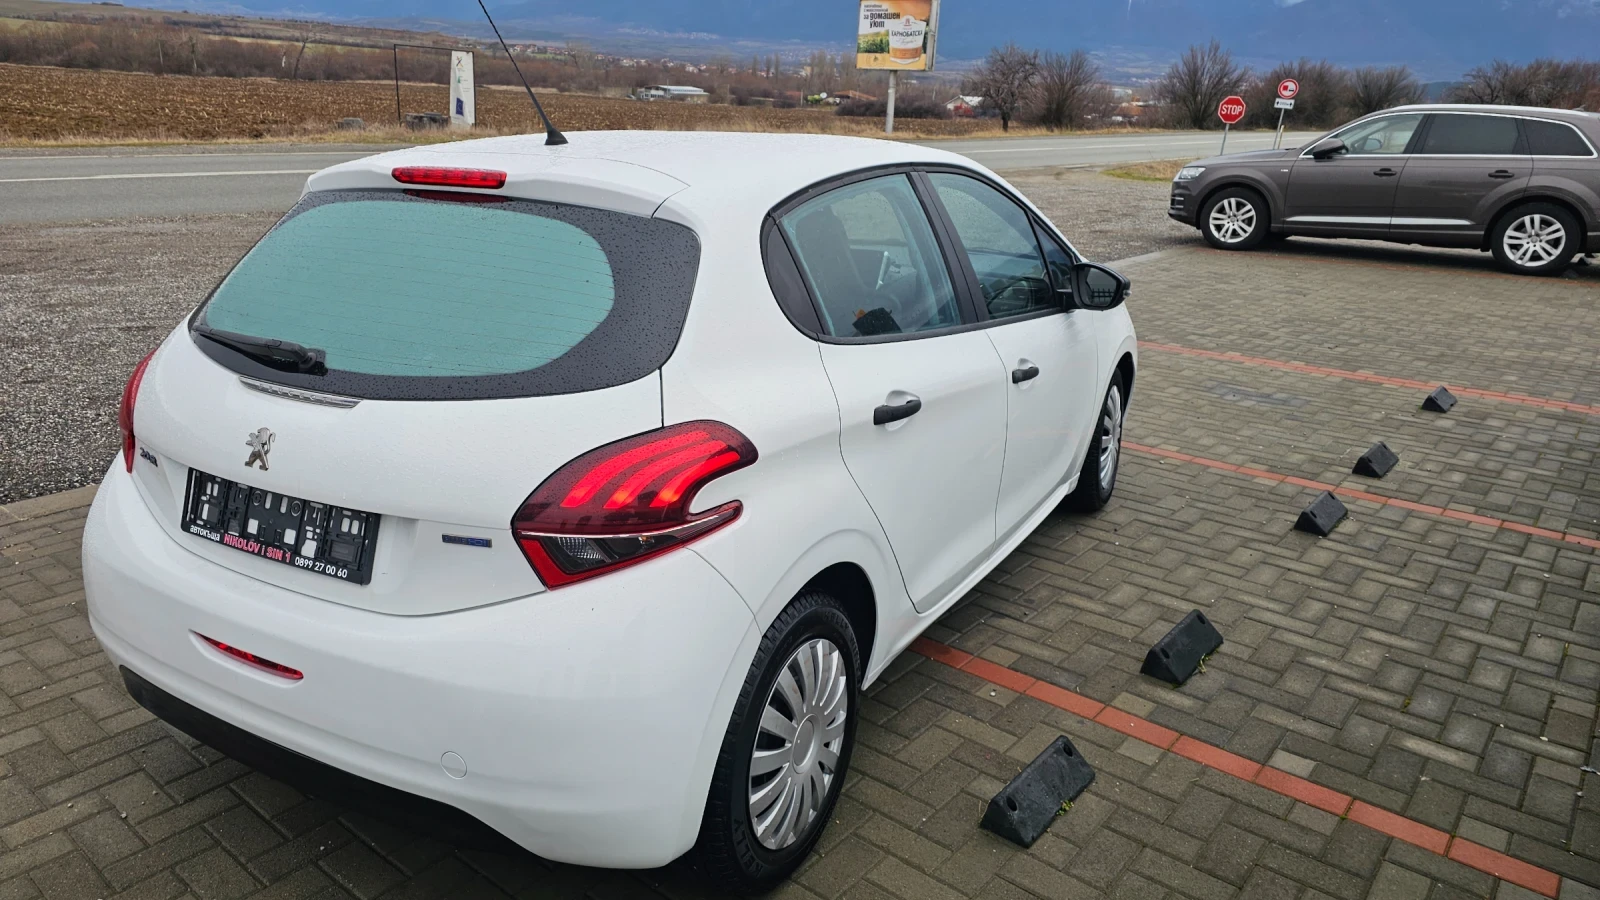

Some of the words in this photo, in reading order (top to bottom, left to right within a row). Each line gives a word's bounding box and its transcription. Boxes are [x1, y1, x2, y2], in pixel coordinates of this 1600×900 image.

[869, 12, 901, 20] домашен
[869, 20, 885, 28] уют
[1221, 104, 1243, 115] STOP
[189, 525, 220, 542] автокъща
[223, 533, 261, 553] NIKOLOV
[266, 546, 284, 561] SIN
[285, 551, 291, 562] 1
[294, 556, 313, 569] 0899
[314, 562, 325, 572] 27
[325, 565, 336, 575] 00
[337, 568, 348, 578] 60
[733, 818, 764, 880] KELLY
